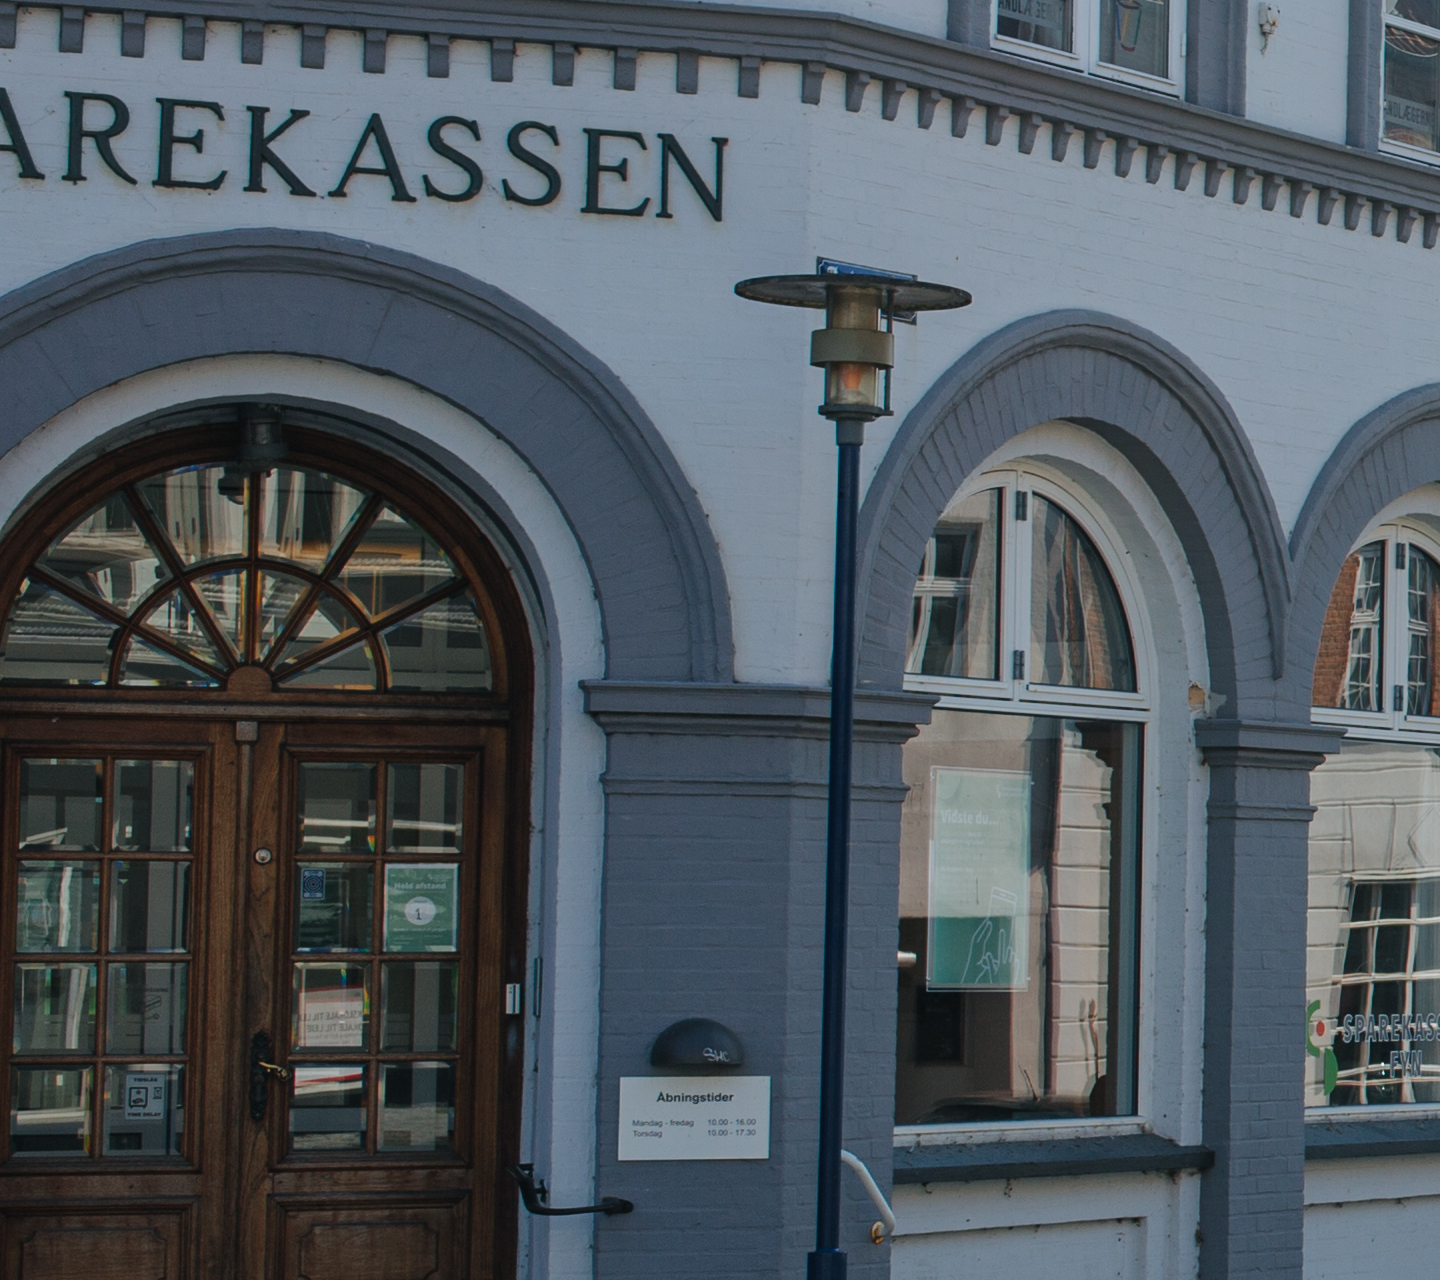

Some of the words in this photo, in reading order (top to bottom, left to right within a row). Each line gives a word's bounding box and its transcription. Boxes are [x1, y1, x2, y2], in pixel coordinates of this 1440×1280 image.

[941, 809, 974, 825] Vidste
[1390, 1050, 1422, 1077] FYN
[657, 1091, 734, 1105] Åbningstider
[632, 1120, 663, 1128] Mandag
[669, 1120, 694, 1128] fredag
[633, 1130, 663, 1138] Torsdag
